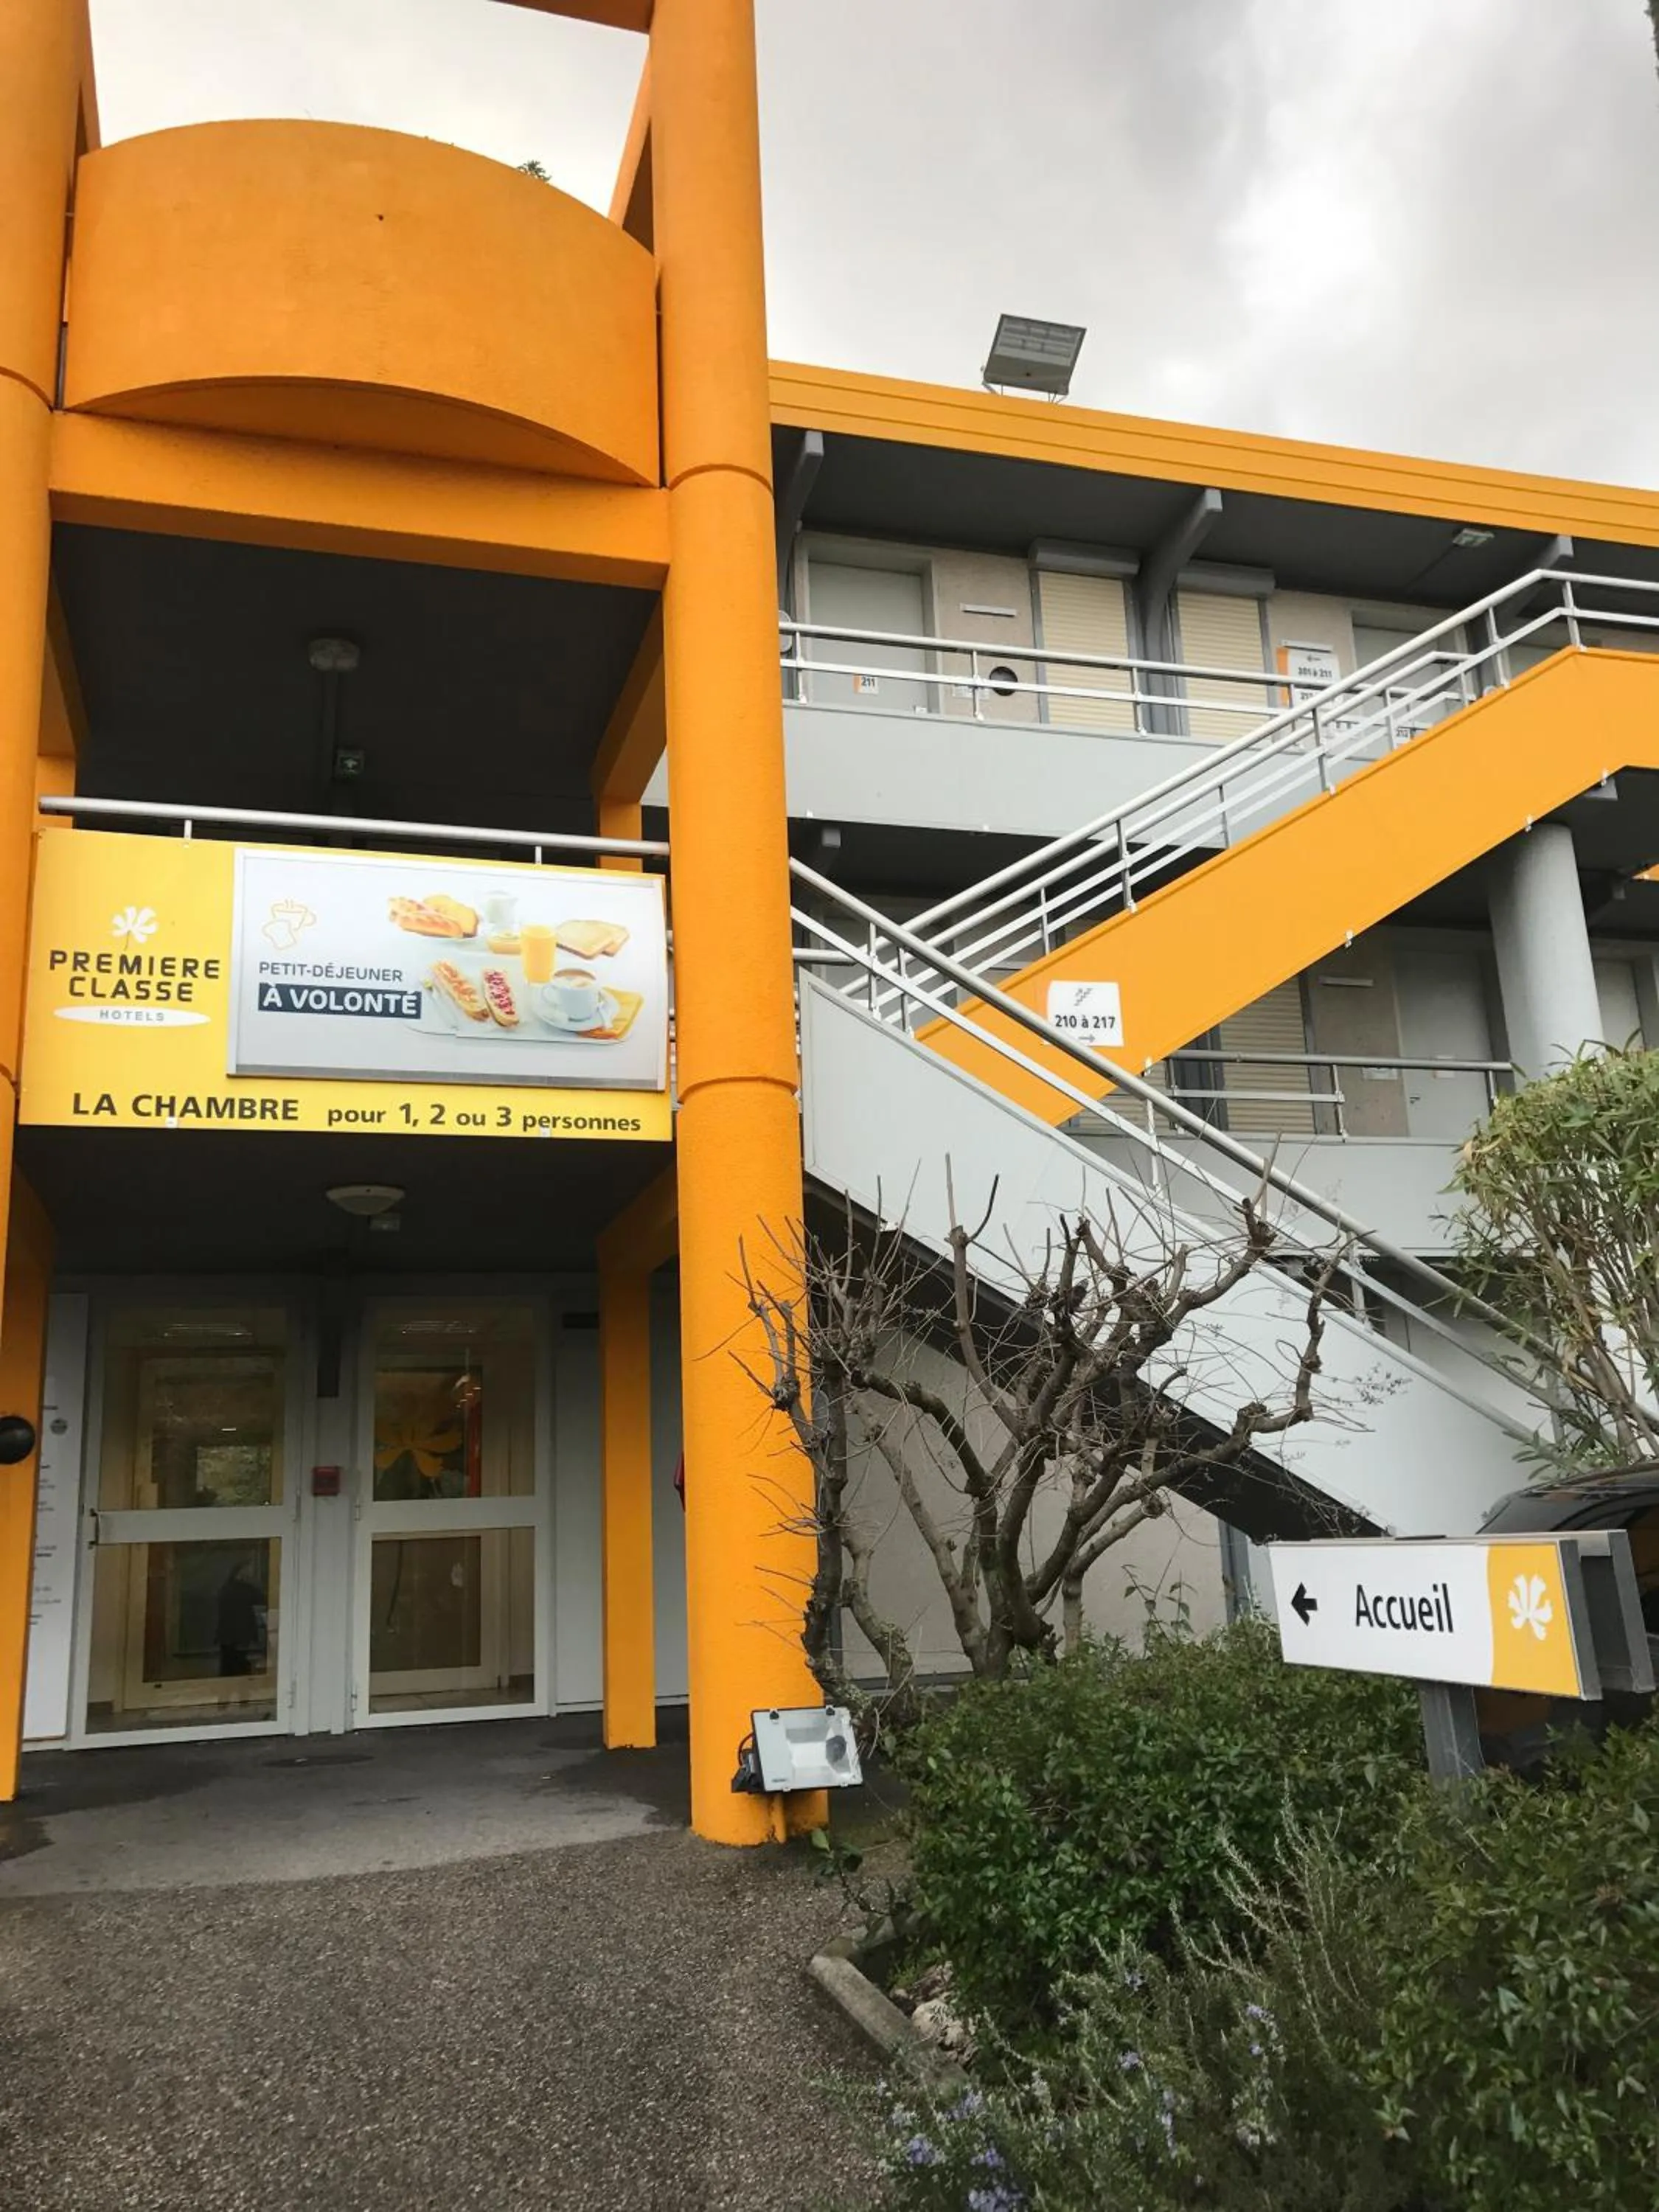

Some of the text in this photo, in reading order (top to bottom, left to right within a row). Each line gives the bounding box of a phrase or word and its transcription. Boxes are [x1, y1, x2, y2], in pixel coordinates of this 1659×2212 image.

[861, 676, 875, 686] 211
[49, 950, 220, 979] PREMIERE
[259, 961, 403, 982] PETIT-DÉJEUNER
[69, 976, 193, 1002] CLASSE
[263, 985, 418, 1015] À VOLONTÉ
[100, 1009, 165, 1022] HOTELS
[1055, 1015, 1116, 1029] 210 à 217
[73, 1093, 641, 1133] LA CHAMBRE pour 1, 2 ou 3 personnes
[1355, 1583, 1454, 1633] Accueil
